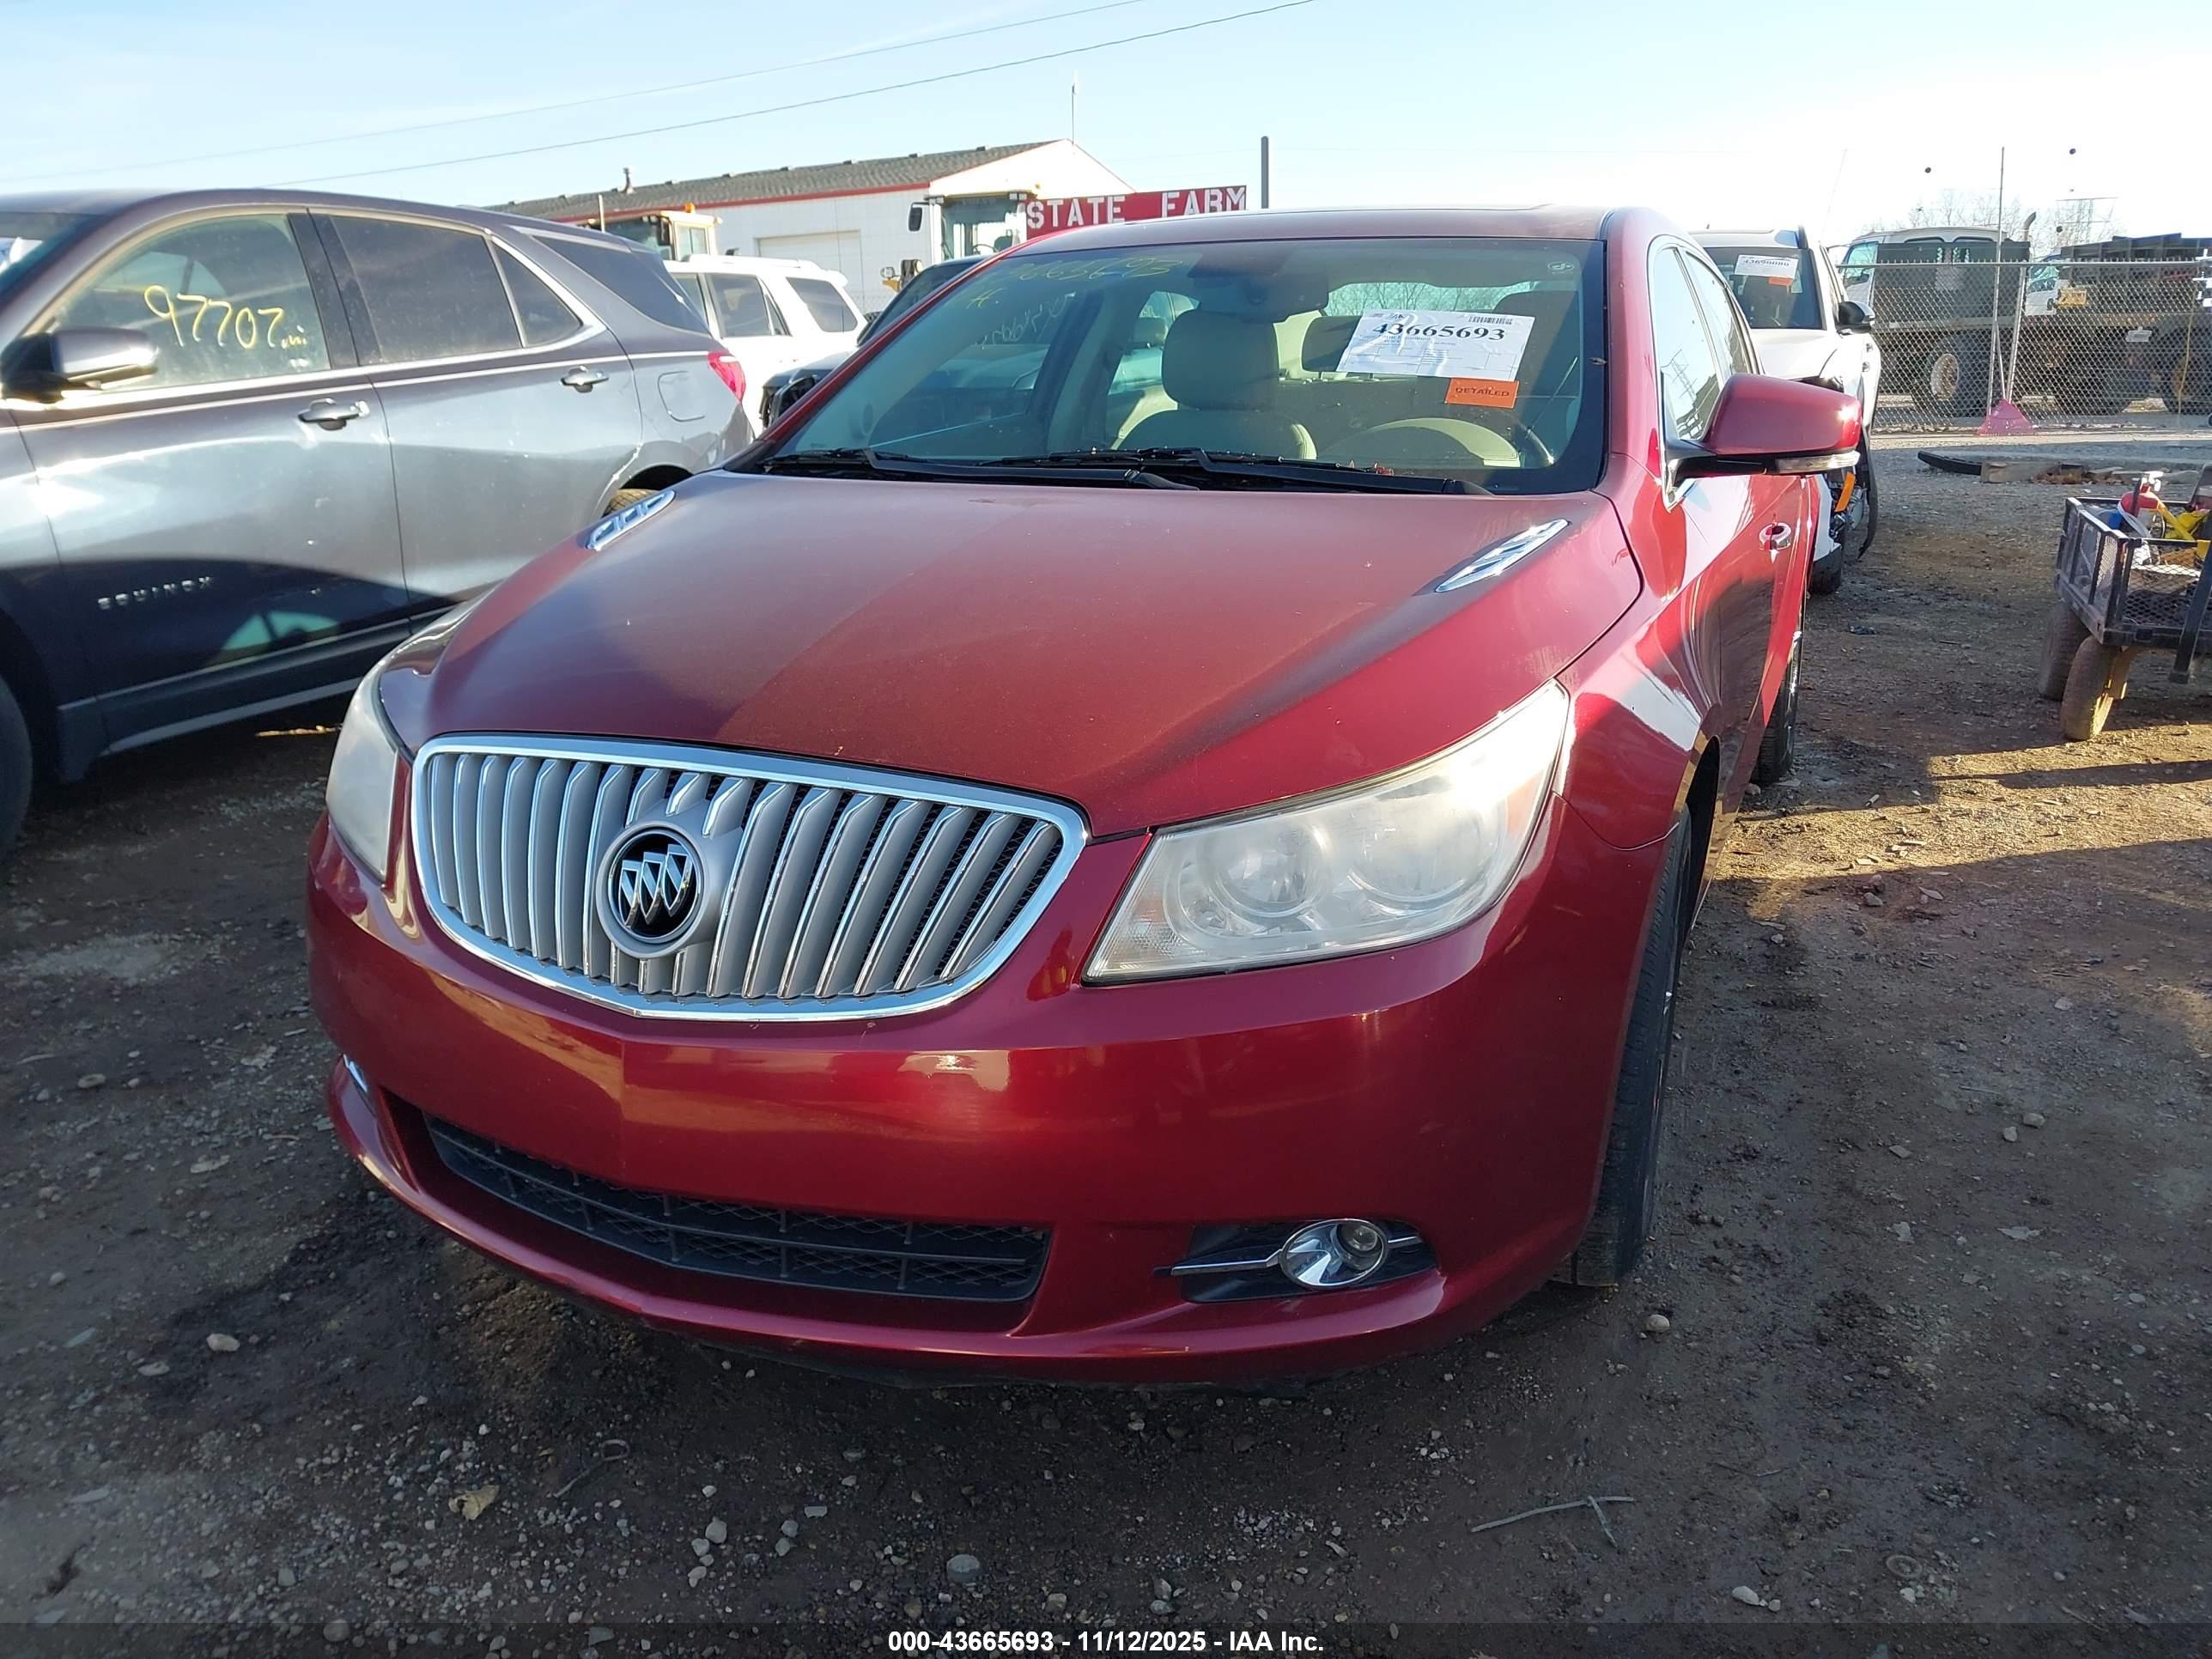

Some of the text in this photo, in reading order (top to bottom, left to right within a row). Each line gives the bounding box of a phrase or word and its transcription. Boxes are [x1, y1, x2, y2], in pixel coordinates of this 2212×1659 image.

[1027, 187, 1245, 229] STATE FARM
[144, 285, 284, 349] 97707
[1372, 323, 1505, 341] 43665693
[1455, 386, 1510, 397] DETAILED
[98, 576, 213, 610] EQUINOX
